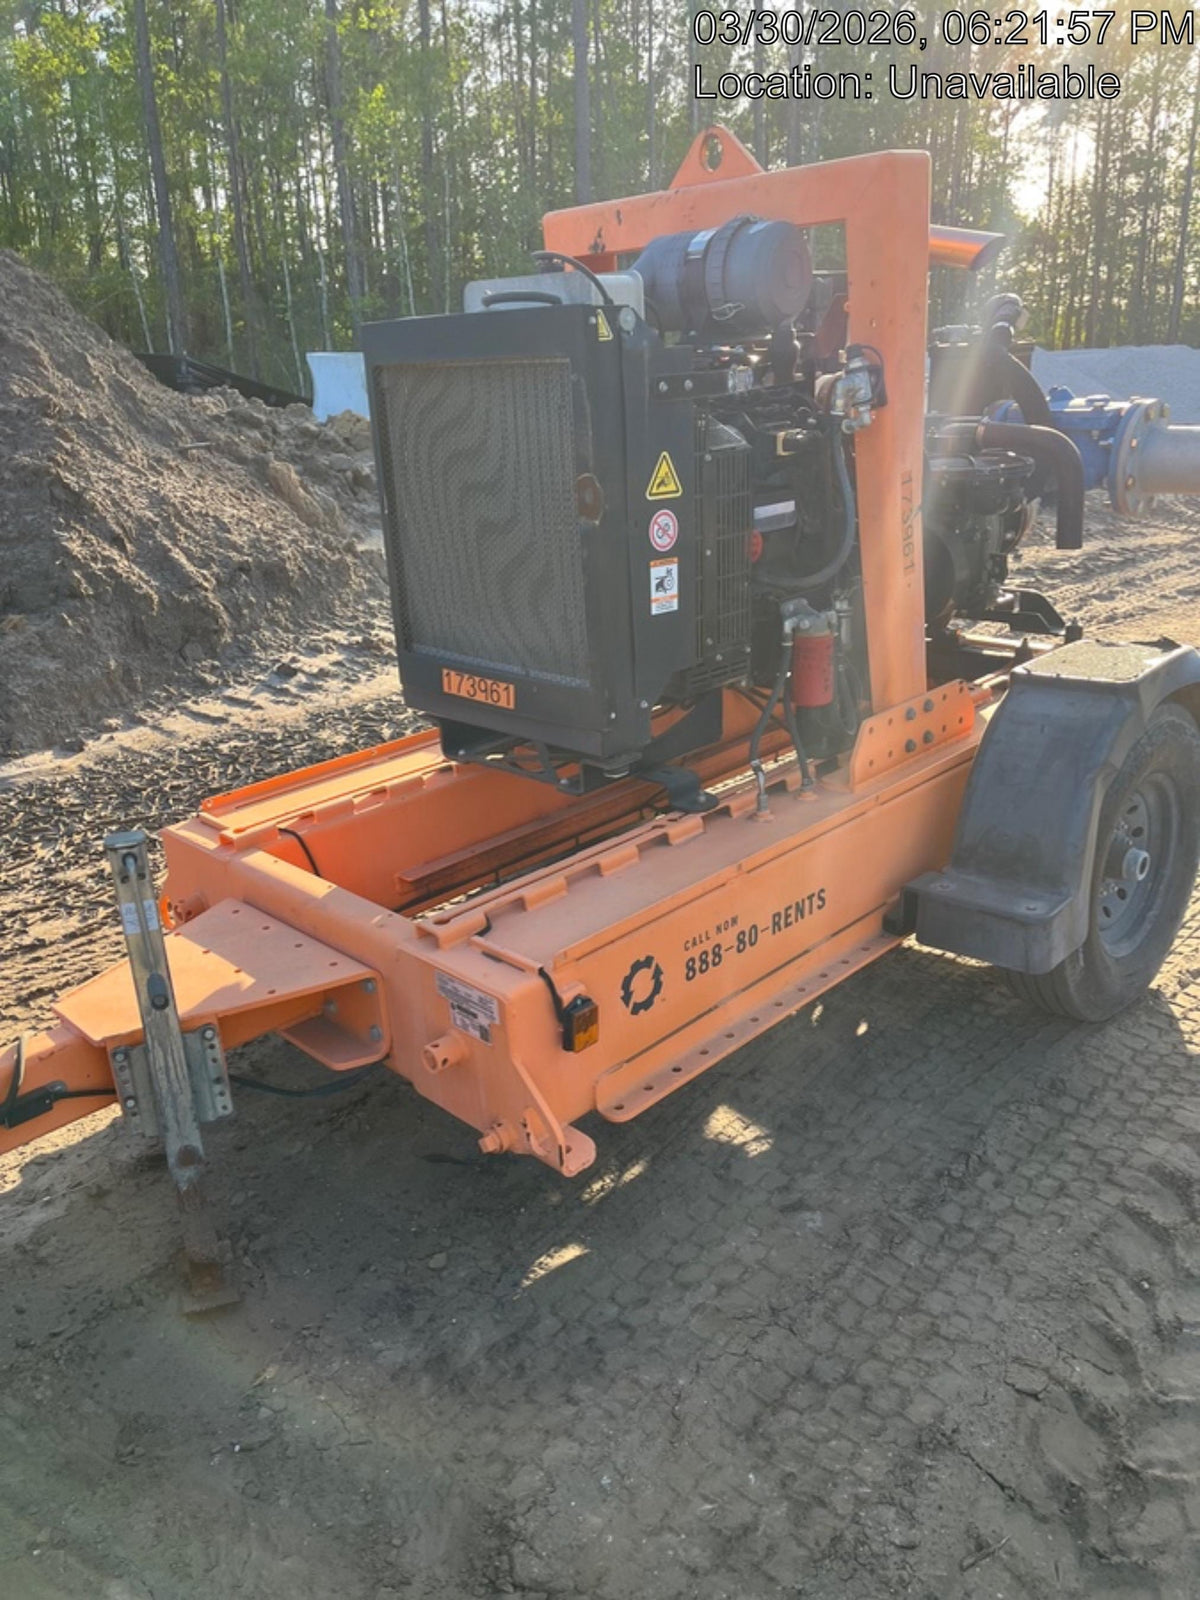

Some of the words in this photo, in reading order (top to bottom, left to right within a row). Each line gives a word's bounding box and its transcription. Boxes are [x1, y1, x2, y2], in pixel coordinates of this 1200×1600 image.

[445, 672, 511, 706] 173961
[684, 930, 711, 951] CALL
[716, 915, 739, 935] NOW
[685, 888, 826, 982] 888-80-RENTS
